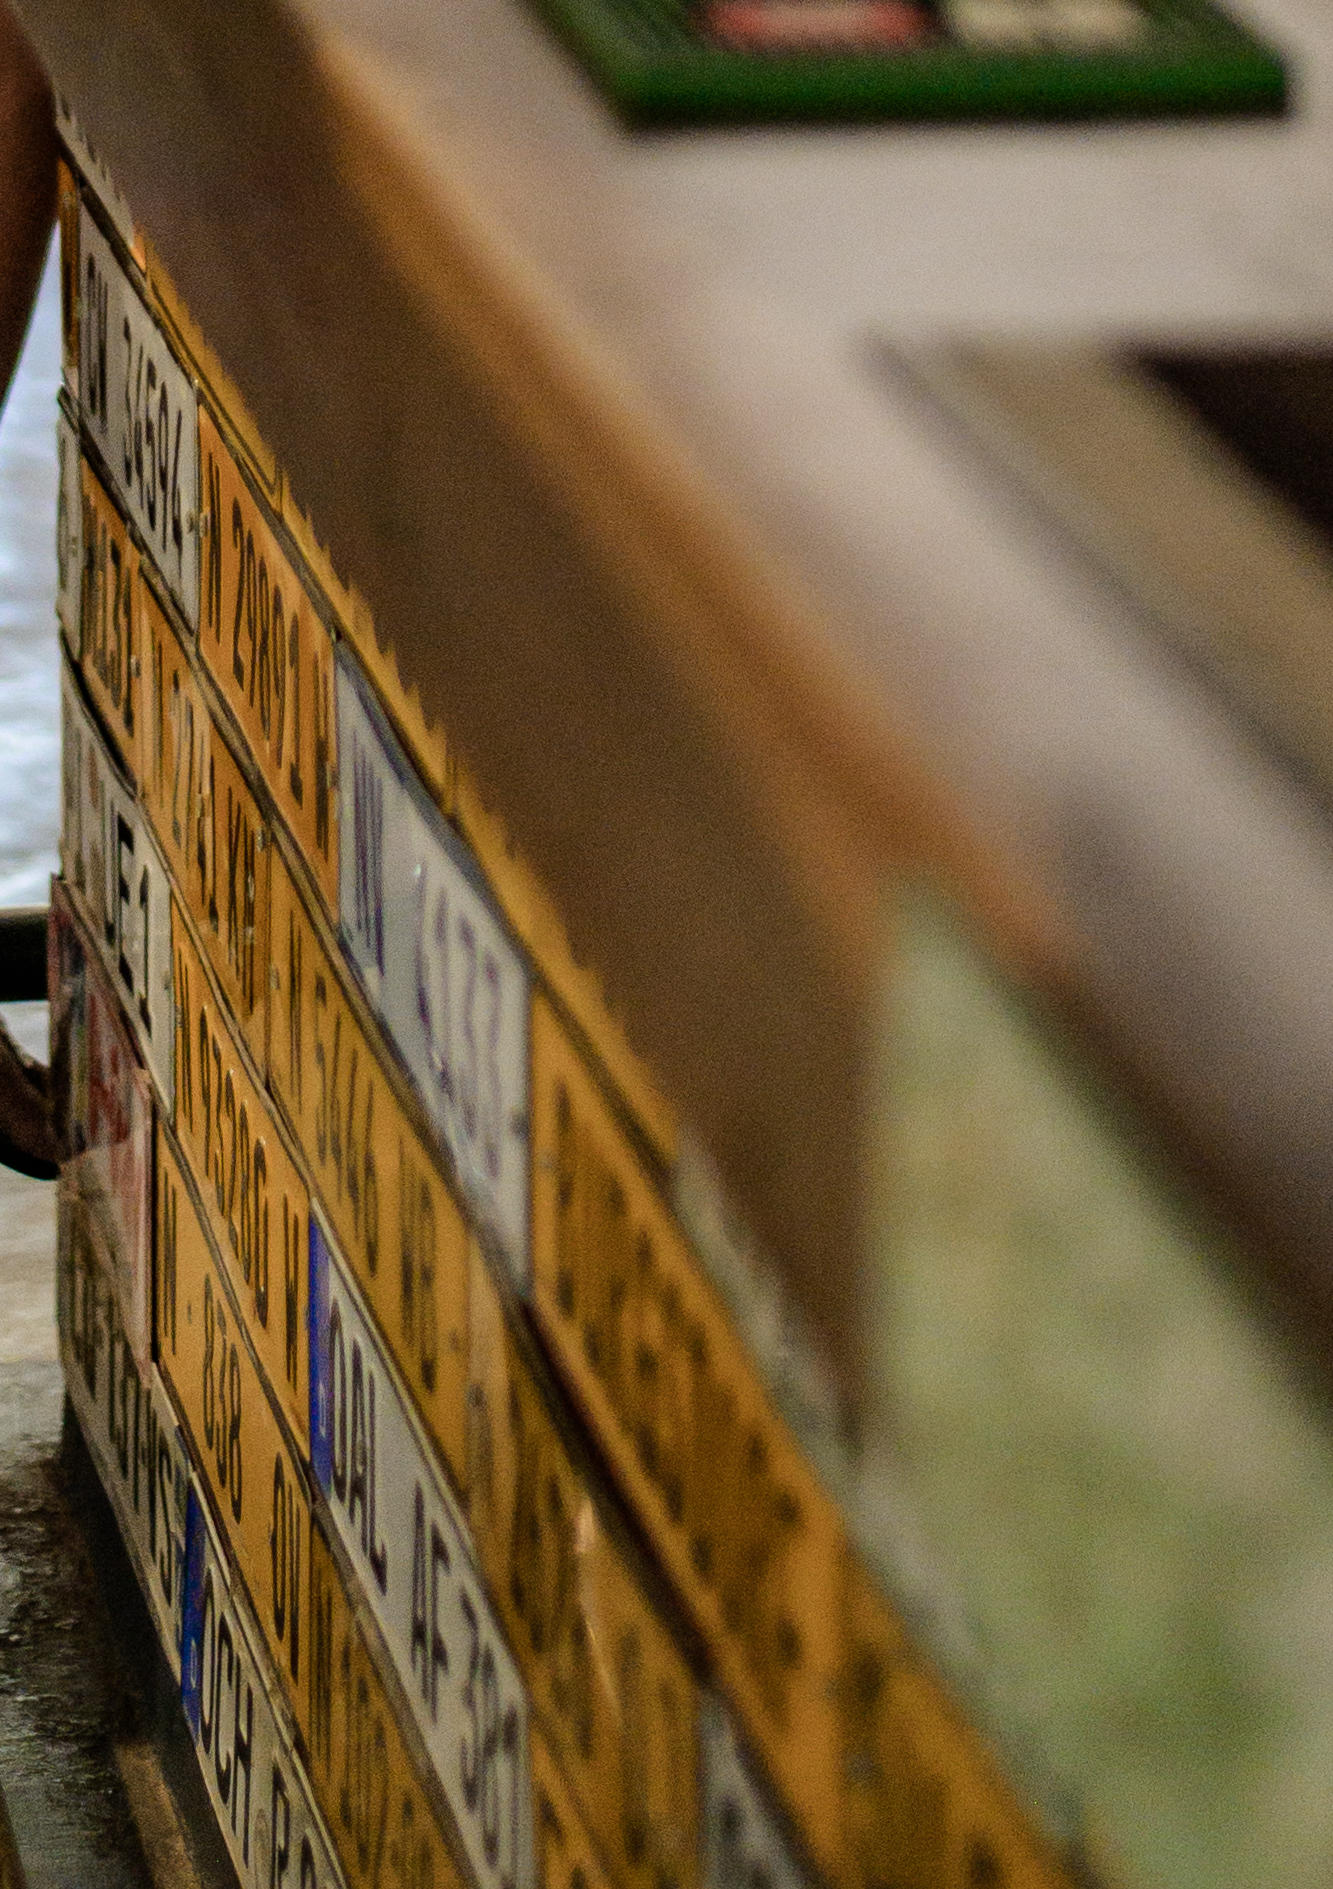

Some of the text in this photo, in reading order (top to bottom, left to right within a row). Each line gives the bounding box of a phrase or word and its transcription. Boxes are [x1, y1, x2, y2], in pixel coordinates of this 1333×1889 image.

[232, 498, 303, 809] 29891
[202, 1273, 243, 1524] 838
[329, 1297, 388, 1597] OAL
[200, 1566, 254, 1869] OCH
